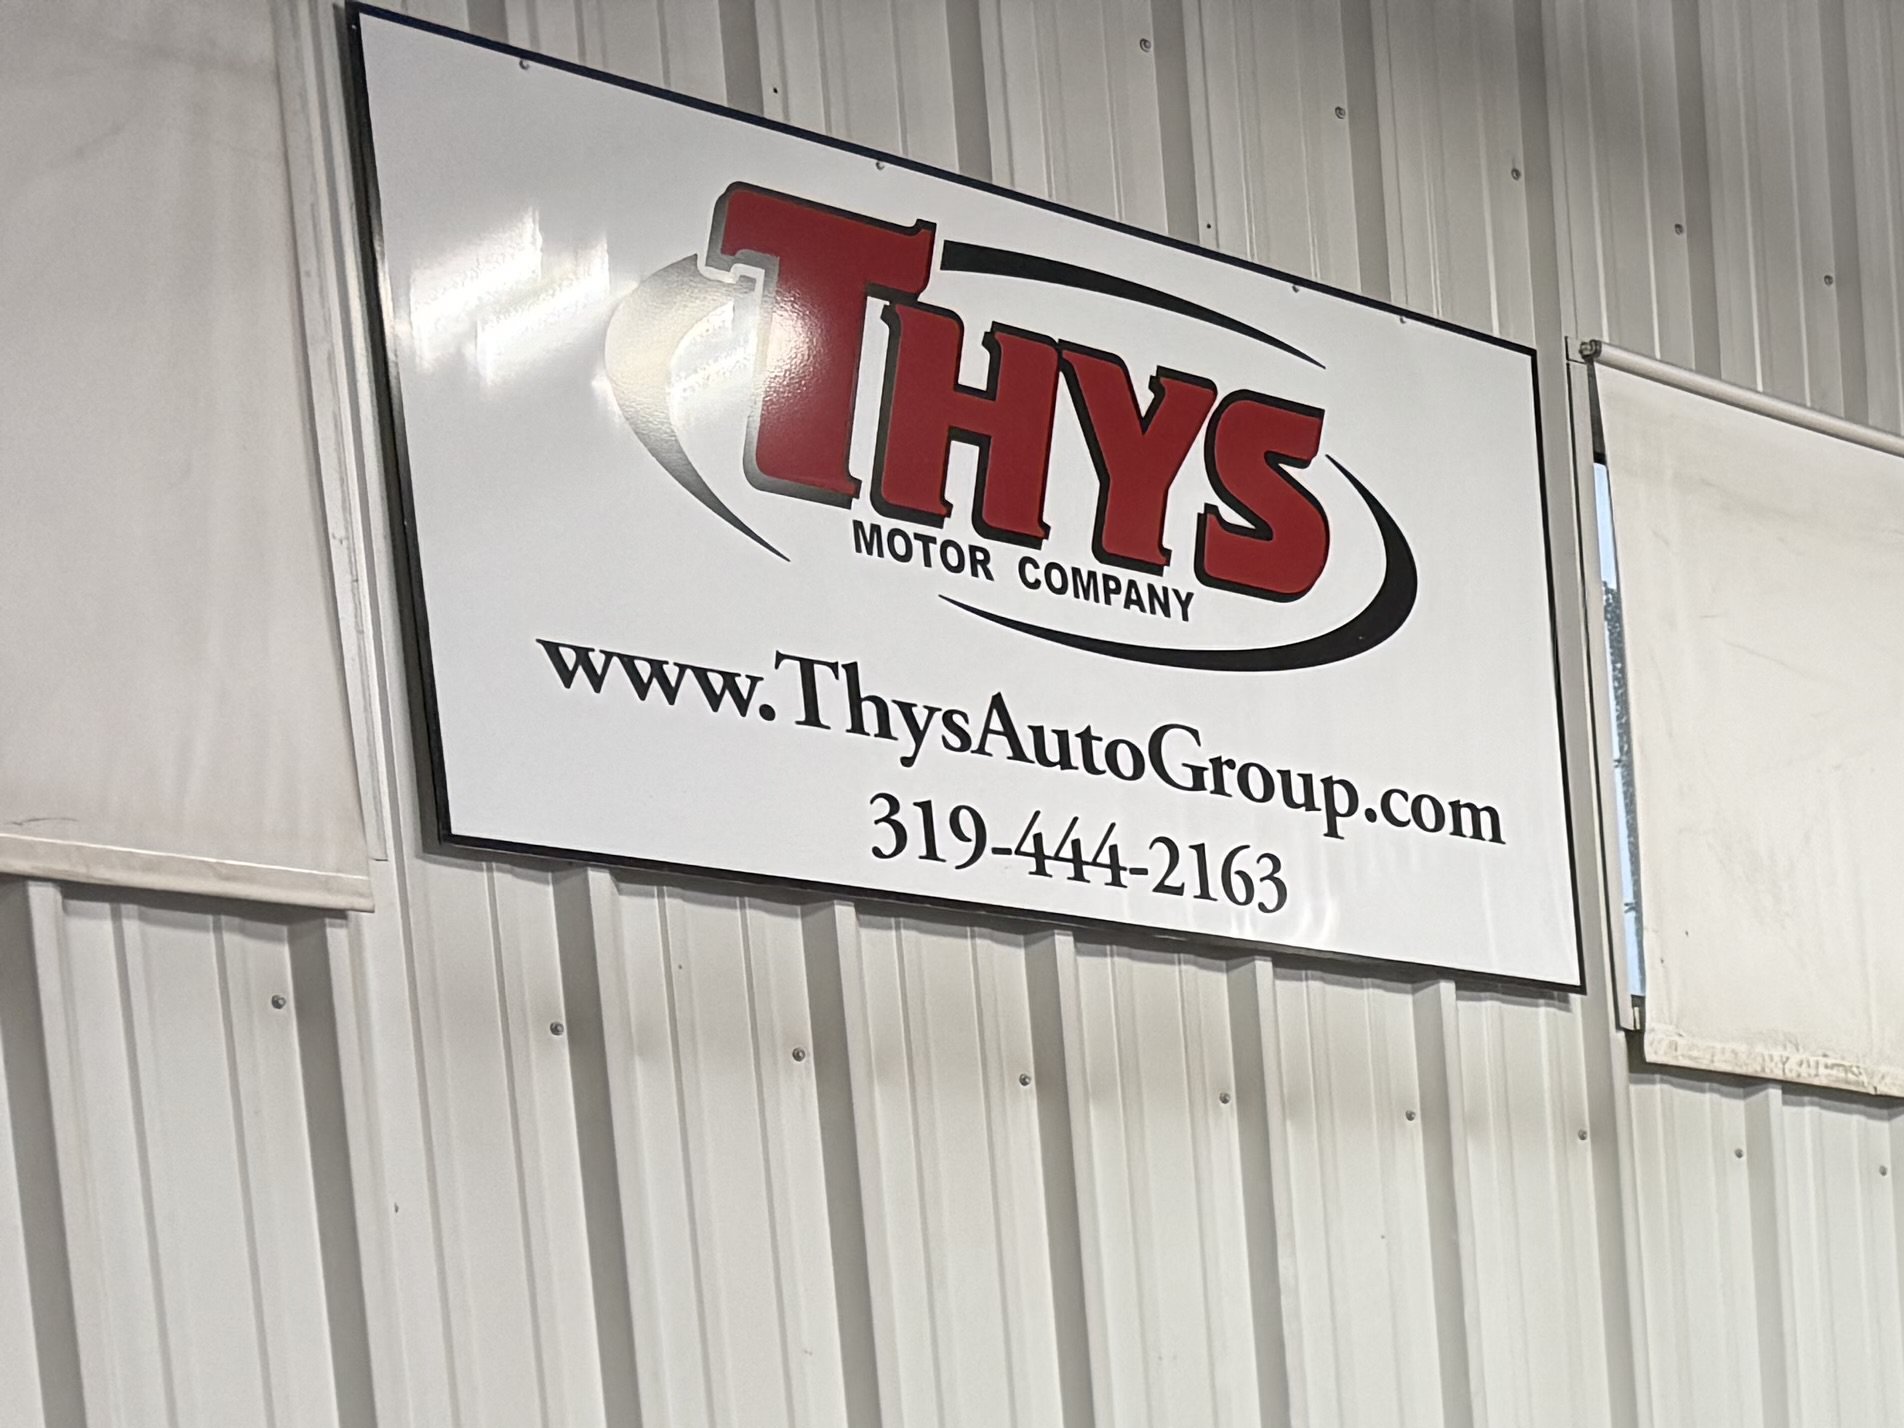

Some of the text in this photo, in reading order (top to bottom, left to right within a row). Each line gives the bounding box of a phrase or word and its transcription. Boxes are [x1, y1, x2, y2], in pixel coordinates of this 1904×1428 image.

[702, 180, 1333, 604] THYS
[852, 519, 1196, 624] MOTOR COMPANY
[536, 637, 1507, 848] www.ThysAutoGroup.com
[868, 791, 1290, 917] 319-444-2163
